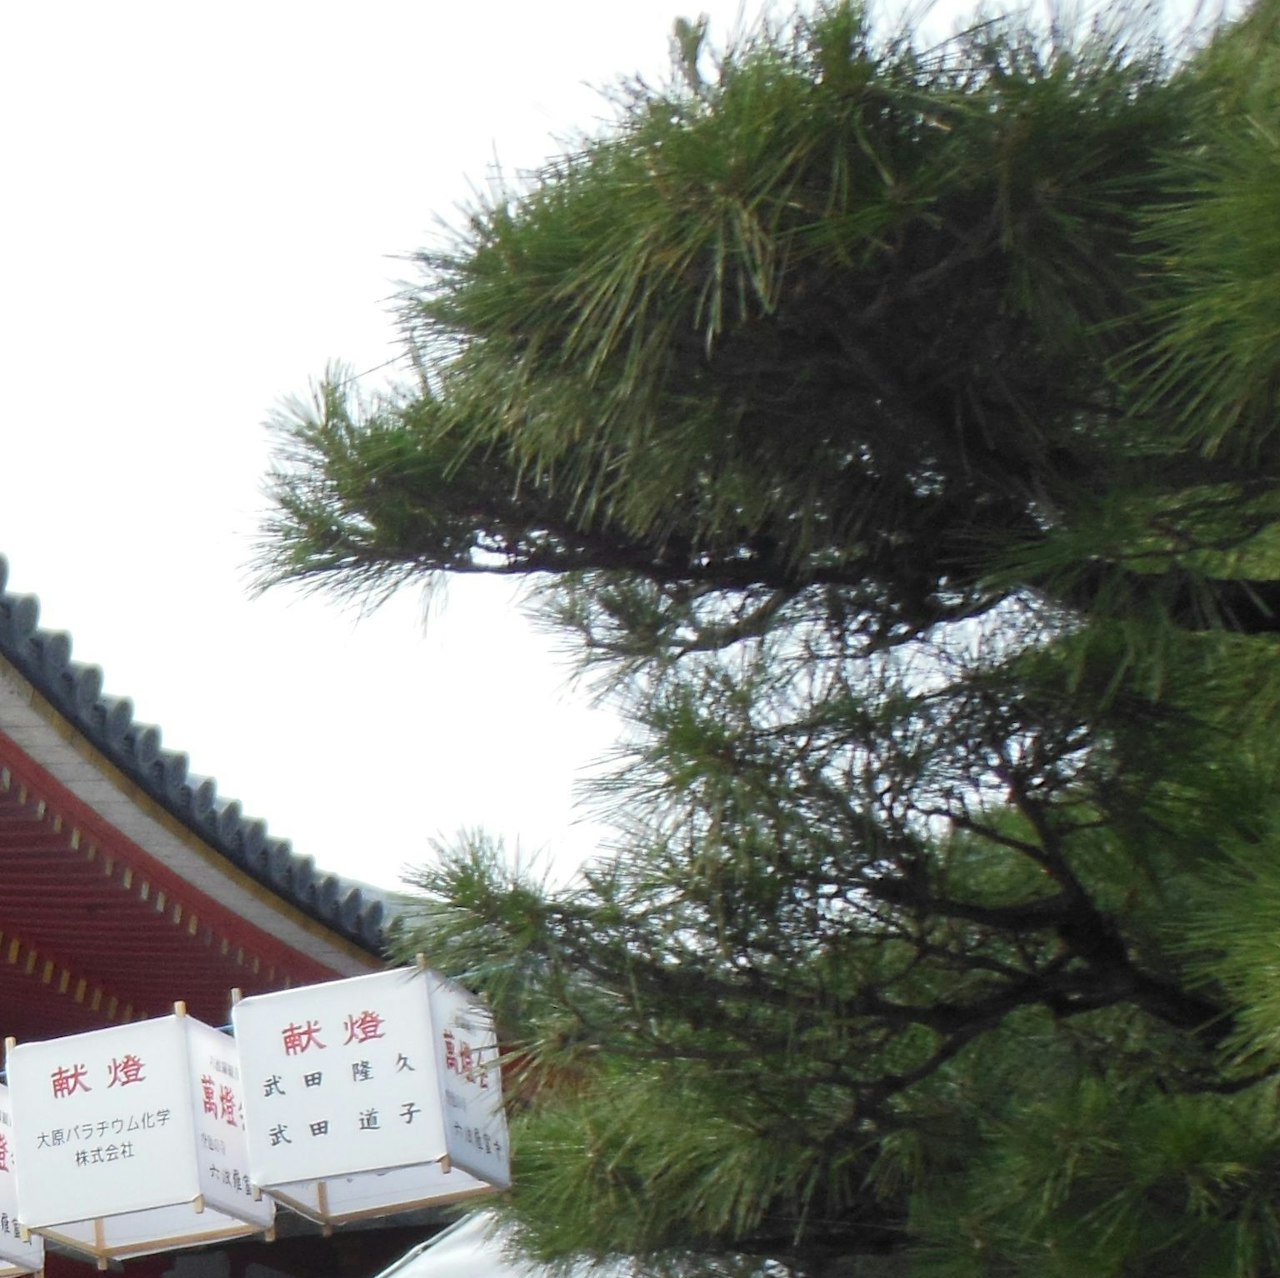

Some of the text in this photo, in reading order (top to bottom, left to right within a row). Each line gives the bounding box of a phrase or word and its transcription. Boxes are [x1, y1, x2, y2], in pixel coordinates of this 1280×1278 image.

[281, 1011, 386, 1056] 献燈
[51, 1054, 146, 1099] 献燈
[263, 1053, 416, 1098] 武田隆久
[269, 1102, 422, 1147] 武田道子
[75, 1141, 135, 1168] 株式会社
